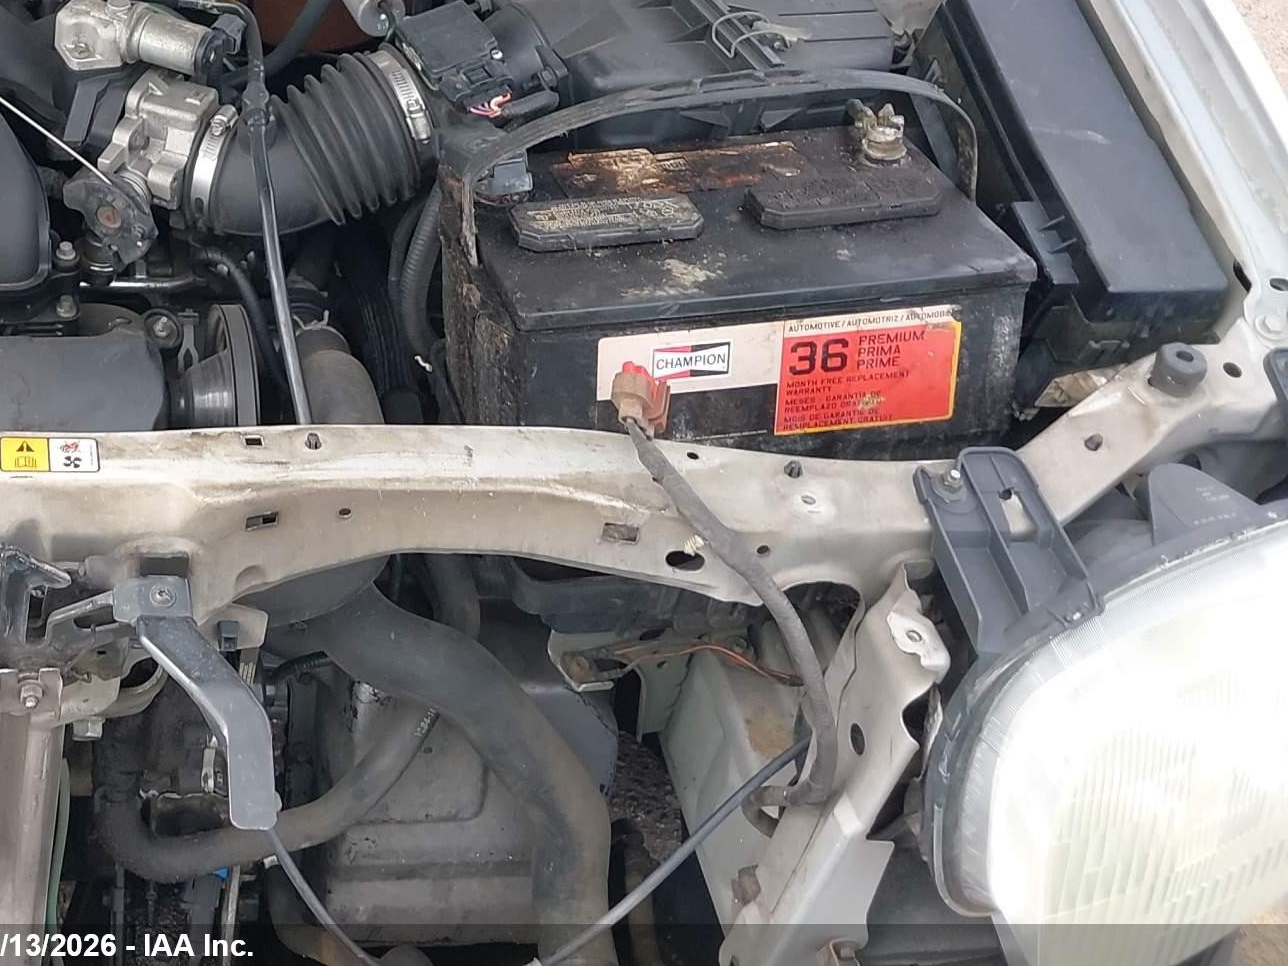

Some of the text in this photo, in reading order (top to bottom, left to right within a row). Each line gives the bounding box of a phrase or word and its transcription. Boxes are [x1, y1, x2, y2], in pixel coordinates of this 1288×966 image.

[789, 320, 841, 332] AUTOMOTIVE
[847, 315, 899, 327] AUTOMOTRIZ
[858, 330, 925, 346] PREMIUM
[789, 338, 849, 376] 36
[858, 344, 901, 358] PRIMA
[656, 353, 726, 370] CHAMPION
[856, 355, 901, 370] PRIME
[786, 371, 910, 388] MONTH FREE REPLACEMENT
[786, 386, 832, 396] WARRANTY
[784, 402, 837, 413] REEMPLAZO
